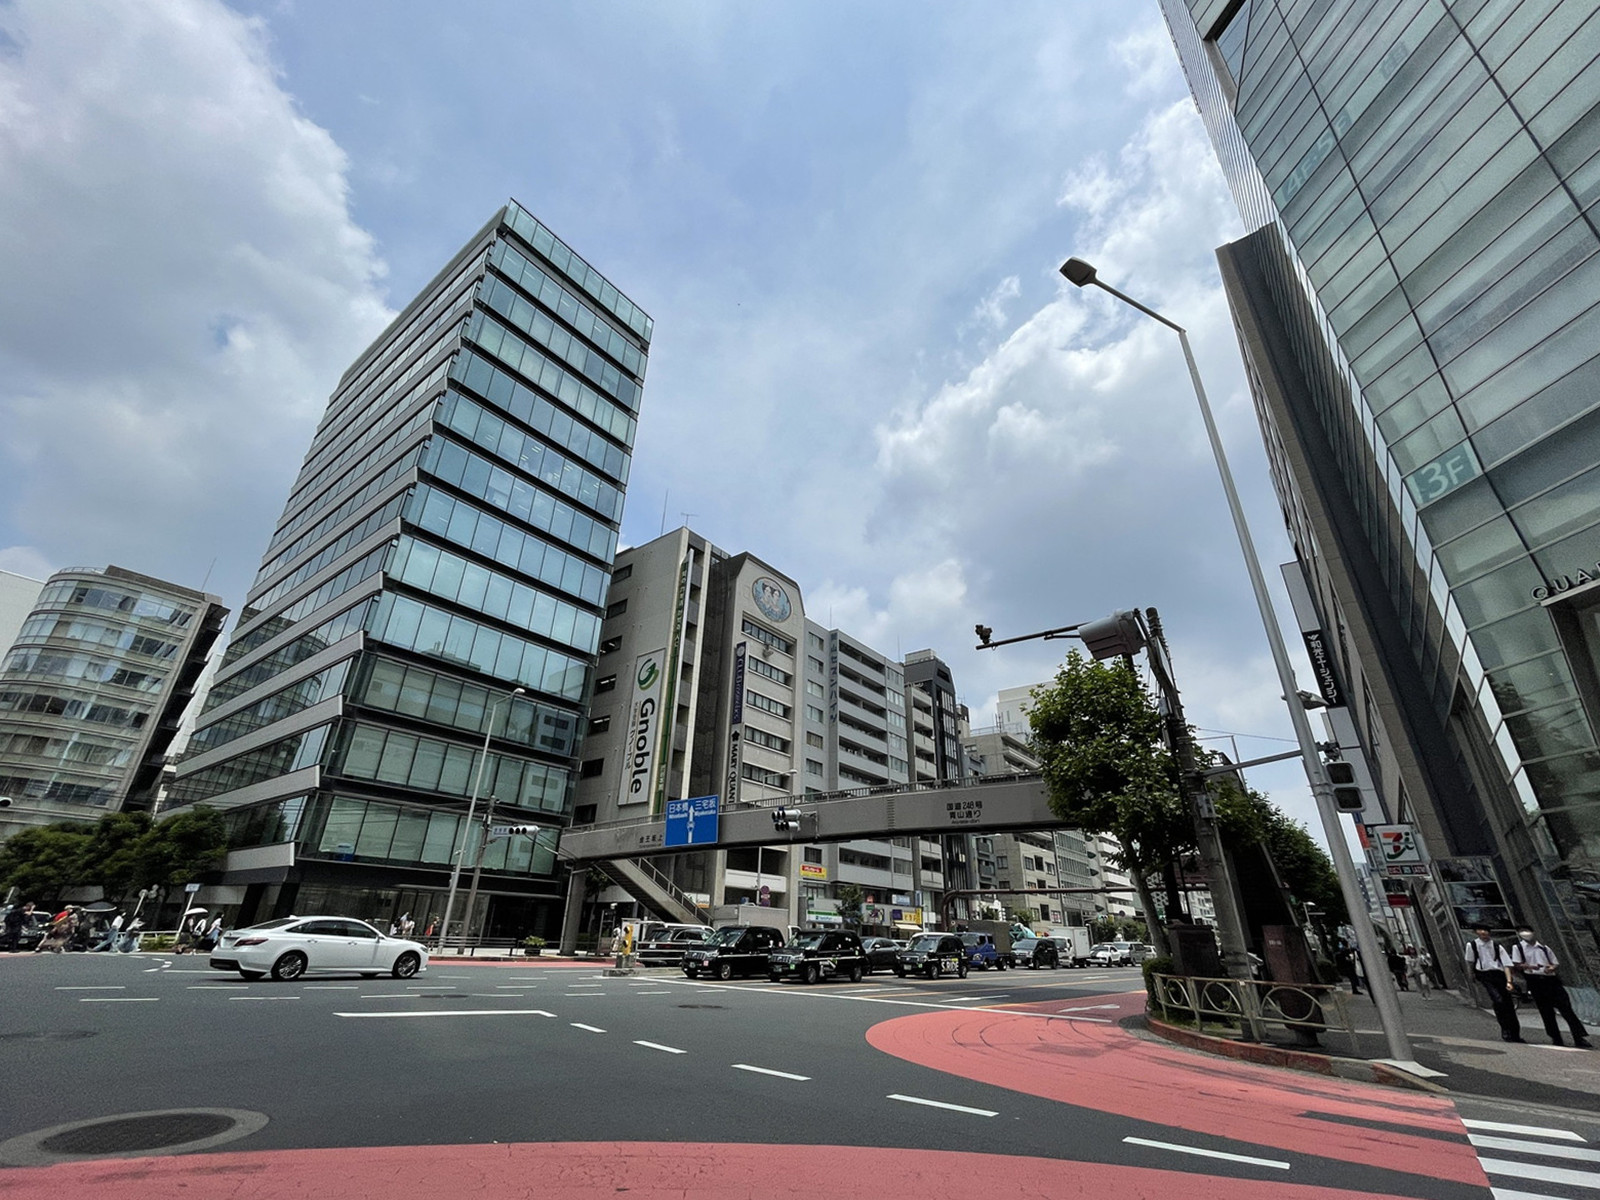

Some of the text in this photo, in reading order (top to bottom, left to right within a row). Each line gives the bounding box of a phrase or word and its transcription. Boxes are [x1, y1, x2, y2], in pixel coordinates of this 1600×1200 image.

[1420, 454, 1465, 499] 3F
[1530, 560, 1600, 601] QUA
[630, 697, 656, 794] Gnoble
[730, 743, 739, 769] MARY
[669, 802, 688, 813] 日本橋
[694, 797, 716, 810] 三宅坂
